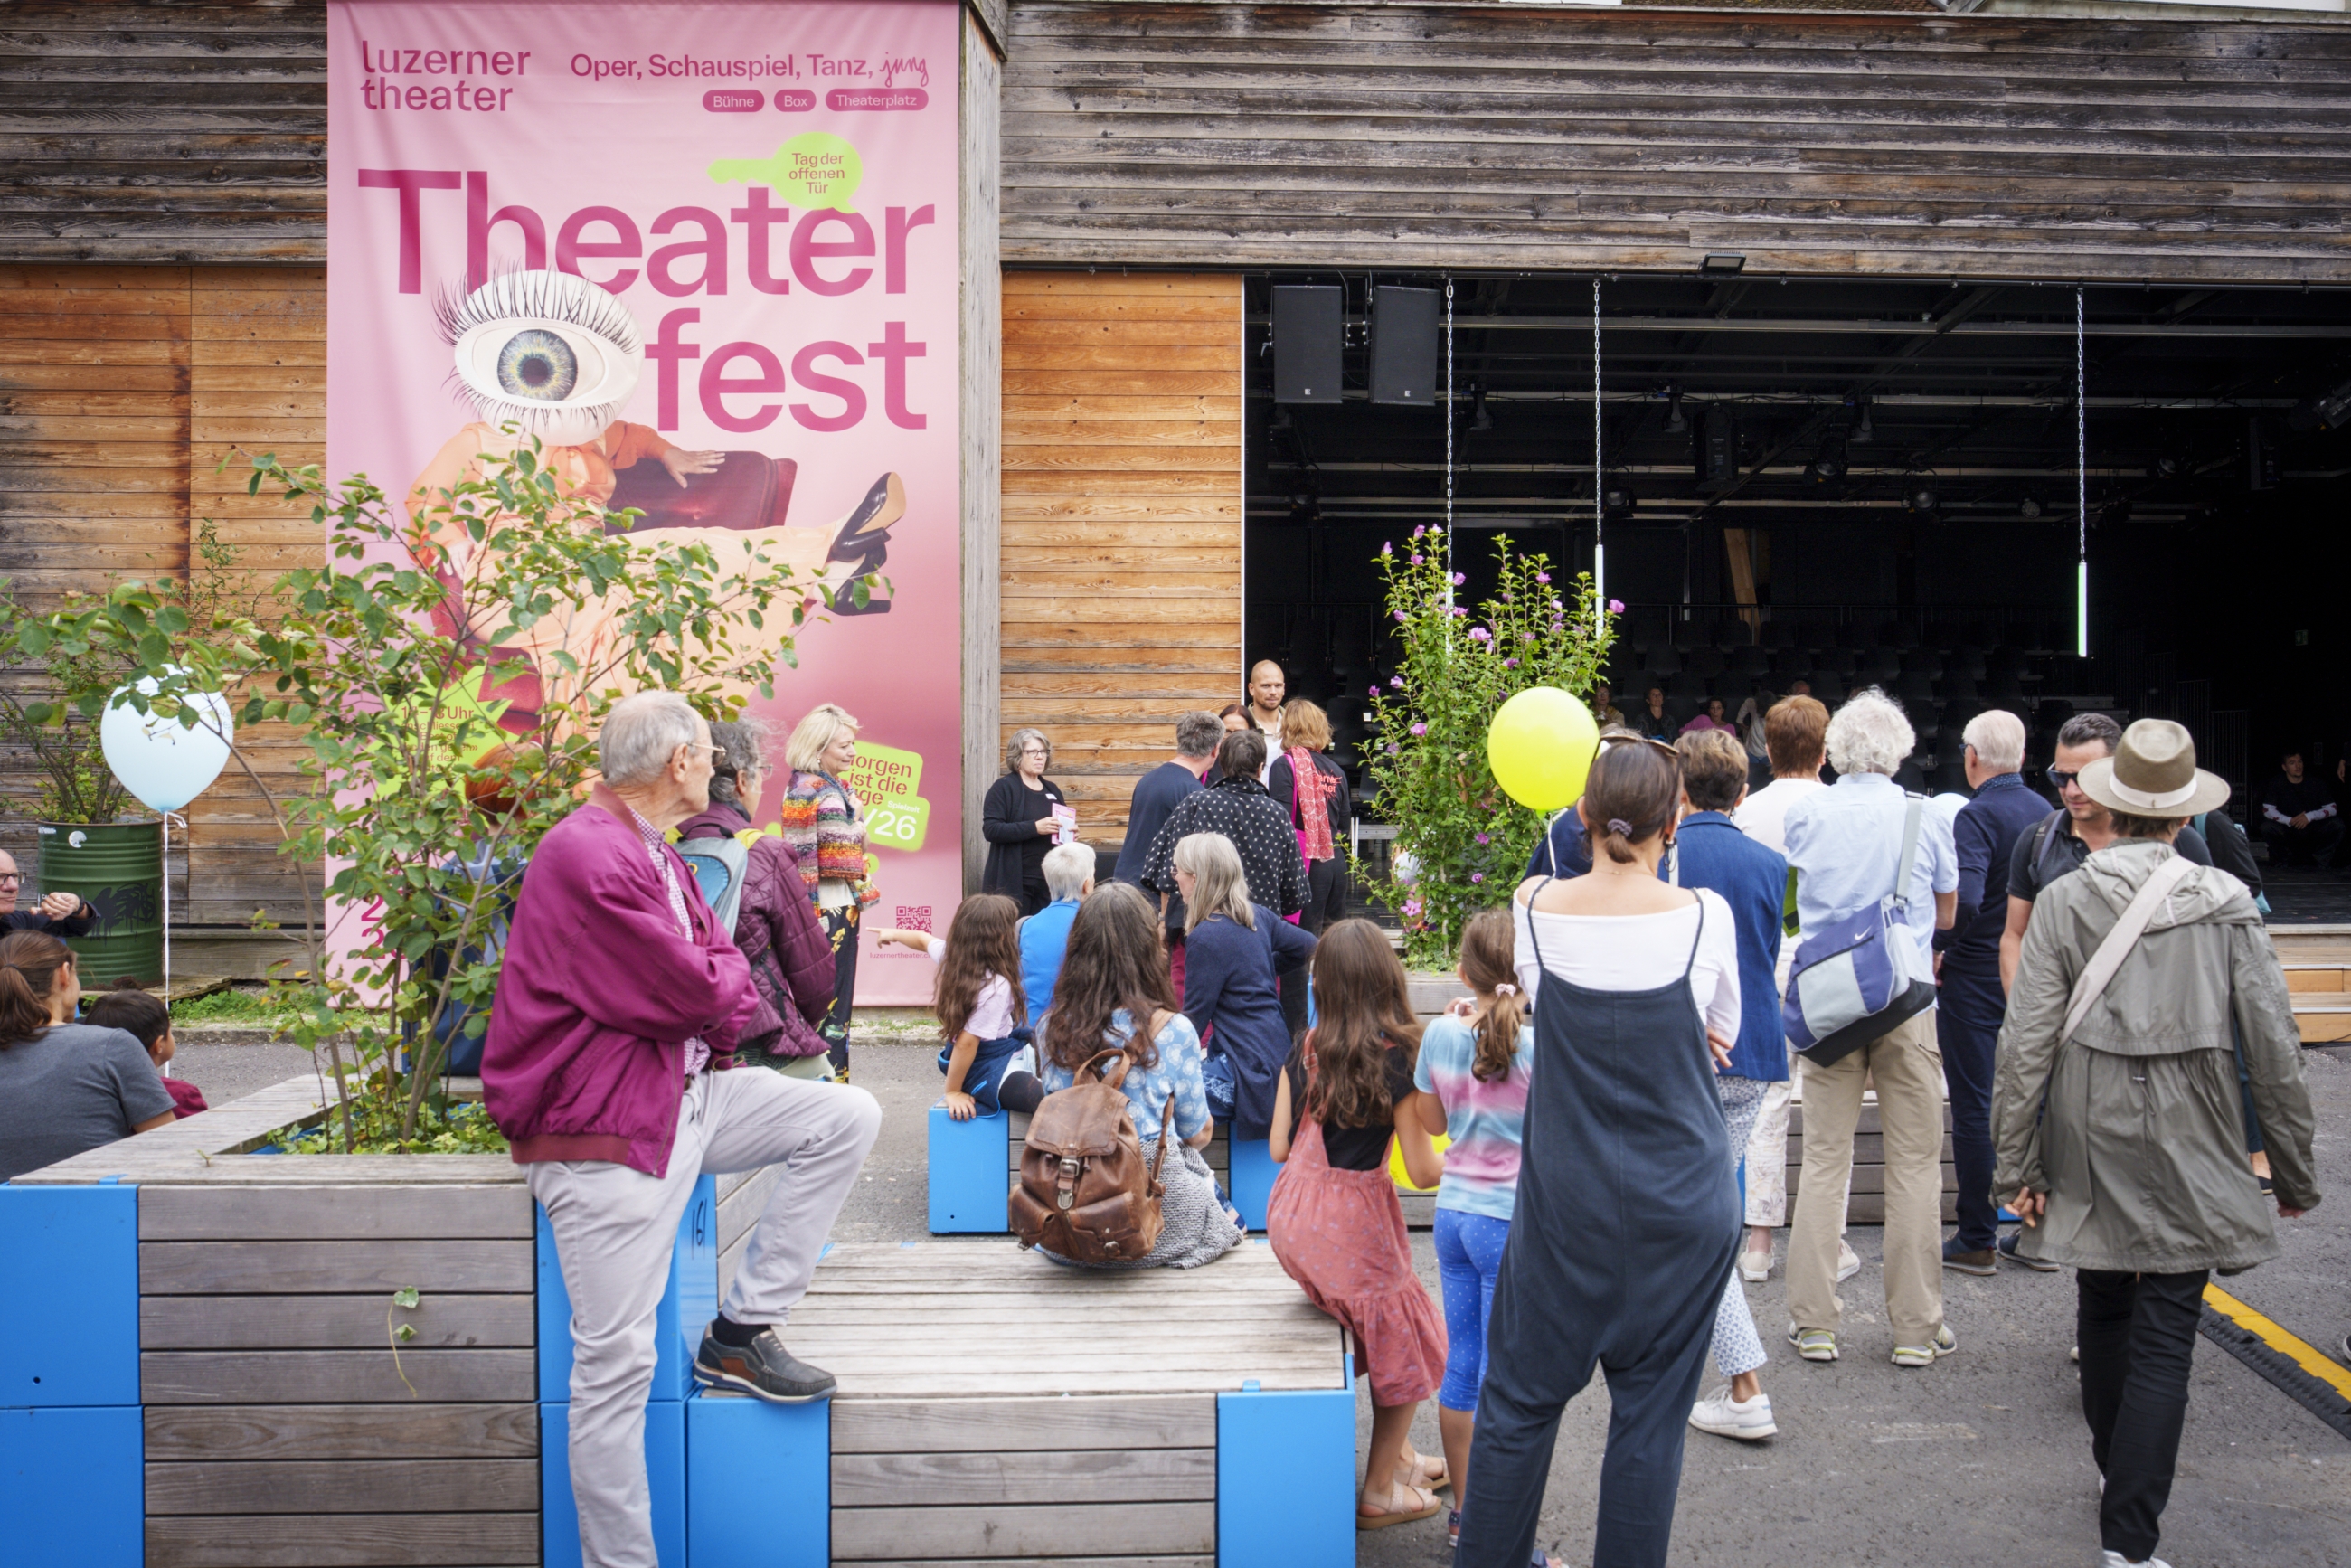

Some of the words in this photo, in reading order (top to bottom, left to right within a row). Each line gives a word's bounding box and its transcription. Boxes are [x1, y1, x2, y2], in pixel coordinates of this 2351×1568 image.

[362, 40, 531, 75] luzerner
[571, 53, 643, 82] Oper,
[648, 53, 801, 82] Schauspiel,
[806, 53, 873, 80] Tanz,
[879, 52, 930, 88] jung
[360, 77, 514, 112] theater
[713, 95, 755, 108] Bühne
[784, 95, 808, 108] Box
[836, 94, 917, 109] Theaterplatz
[791, 152, 818, 168] Tag
[820, 152, 845, 165] der
[788, 167, 845, 180] offenen
[806, 181, 828, 194] Tür
[358, 168, 935, 298] Theater
[644, 307, 927, 433] fest
[448, 706, 474, 720] Uhr
[850, 769, 873, 789] ist
[877, 776, 908, 796] die
[887, 799, 921, 814] Spielzeit
